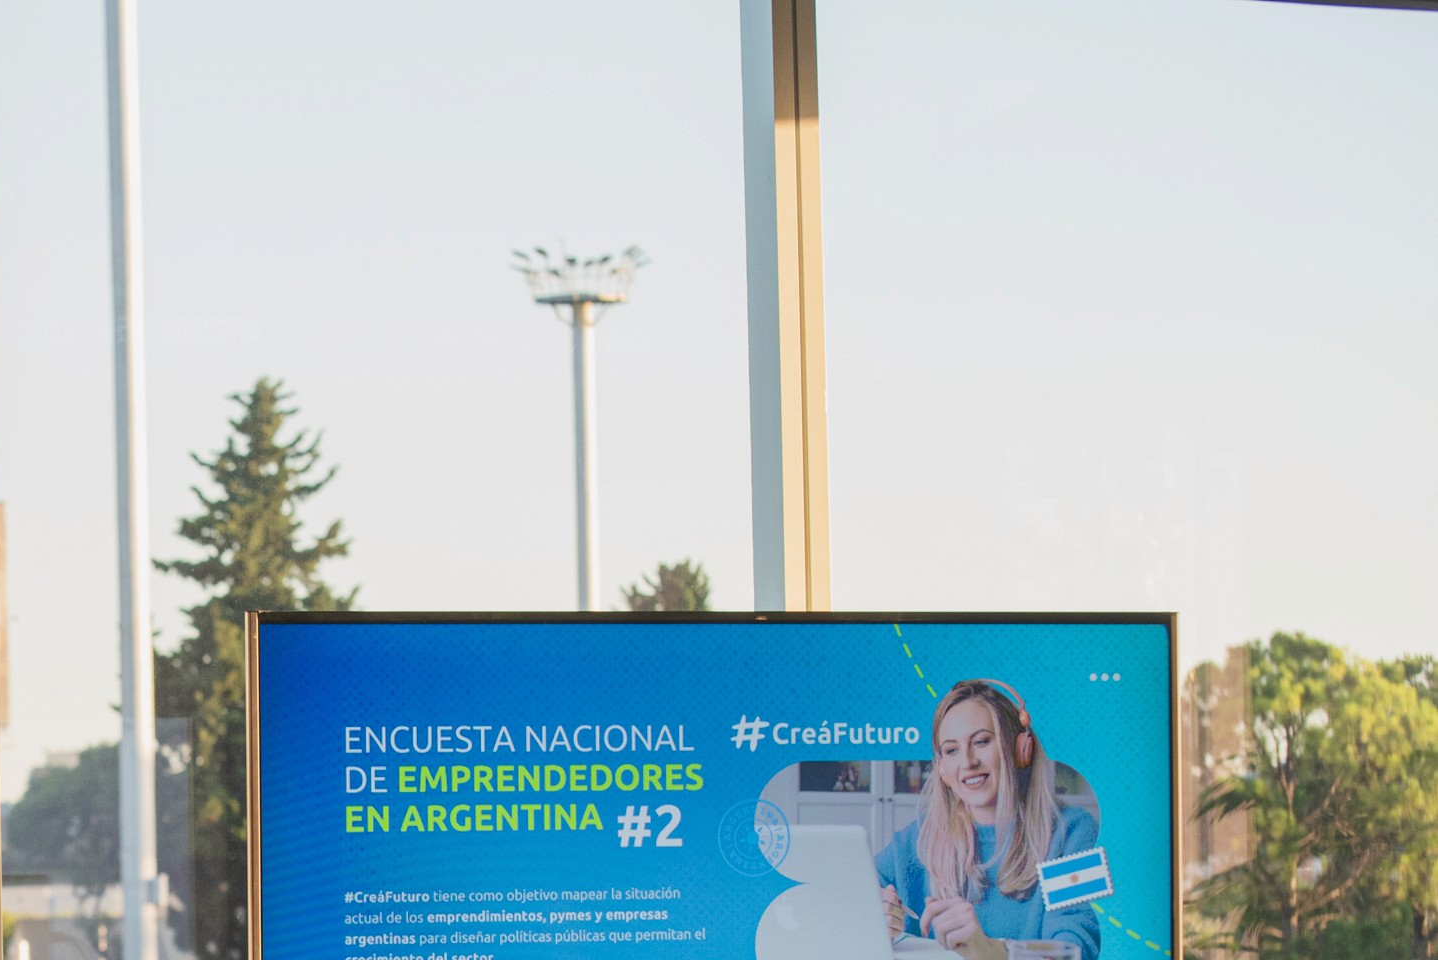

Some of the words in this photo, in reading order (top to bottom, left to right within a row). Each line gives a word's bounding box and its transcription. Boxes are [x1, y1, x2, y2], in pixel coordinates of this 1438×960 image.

[345, 726, 515, 753] ENCUESTA
[525, 725, 694, 752] NACIONAL
[730, 714, 920, 752] #CreáFuturo
[345, 766, 388, 793] DE
[398, 763, 704, 793] EMPRENDEDORES
[345, 805, 390, 833] EN
[400, 803, 604, 832] ARGENTINA
[617, 804, 683, 847] #2
[344, 890, 430, 904] #CreáFuturo
[433, 890, 466, 902] tiene
[468, 891, 503, 902] como
[506, 888, 558, 904] objetivo
[562, 890, 608, 902] mapear
[612, 887, 622, 900] la
[625, 886, 681, 900] situación
[344, 912, 383, 925] actual
[386, 911, 402, 924] de
[406, 911, 424, 923] los
[427, 909, 547, 925] emprendimientos,
[550, 911, 592, 923] pymes
[595, 911, 603, 923] y
[606, 910, 668, 923] empresas
[344, 932, 416, 947] argentinas
[419, 934, 448, 946] para
[450, 931, 496, 944] diseñar
[500, 930, 552, 945] políticas
[555, 929, 606, 944] públicas
[609, 930, 632, 943] que
[635, 928, 691, 943] permitan
[694, 927, 707, 940] el
